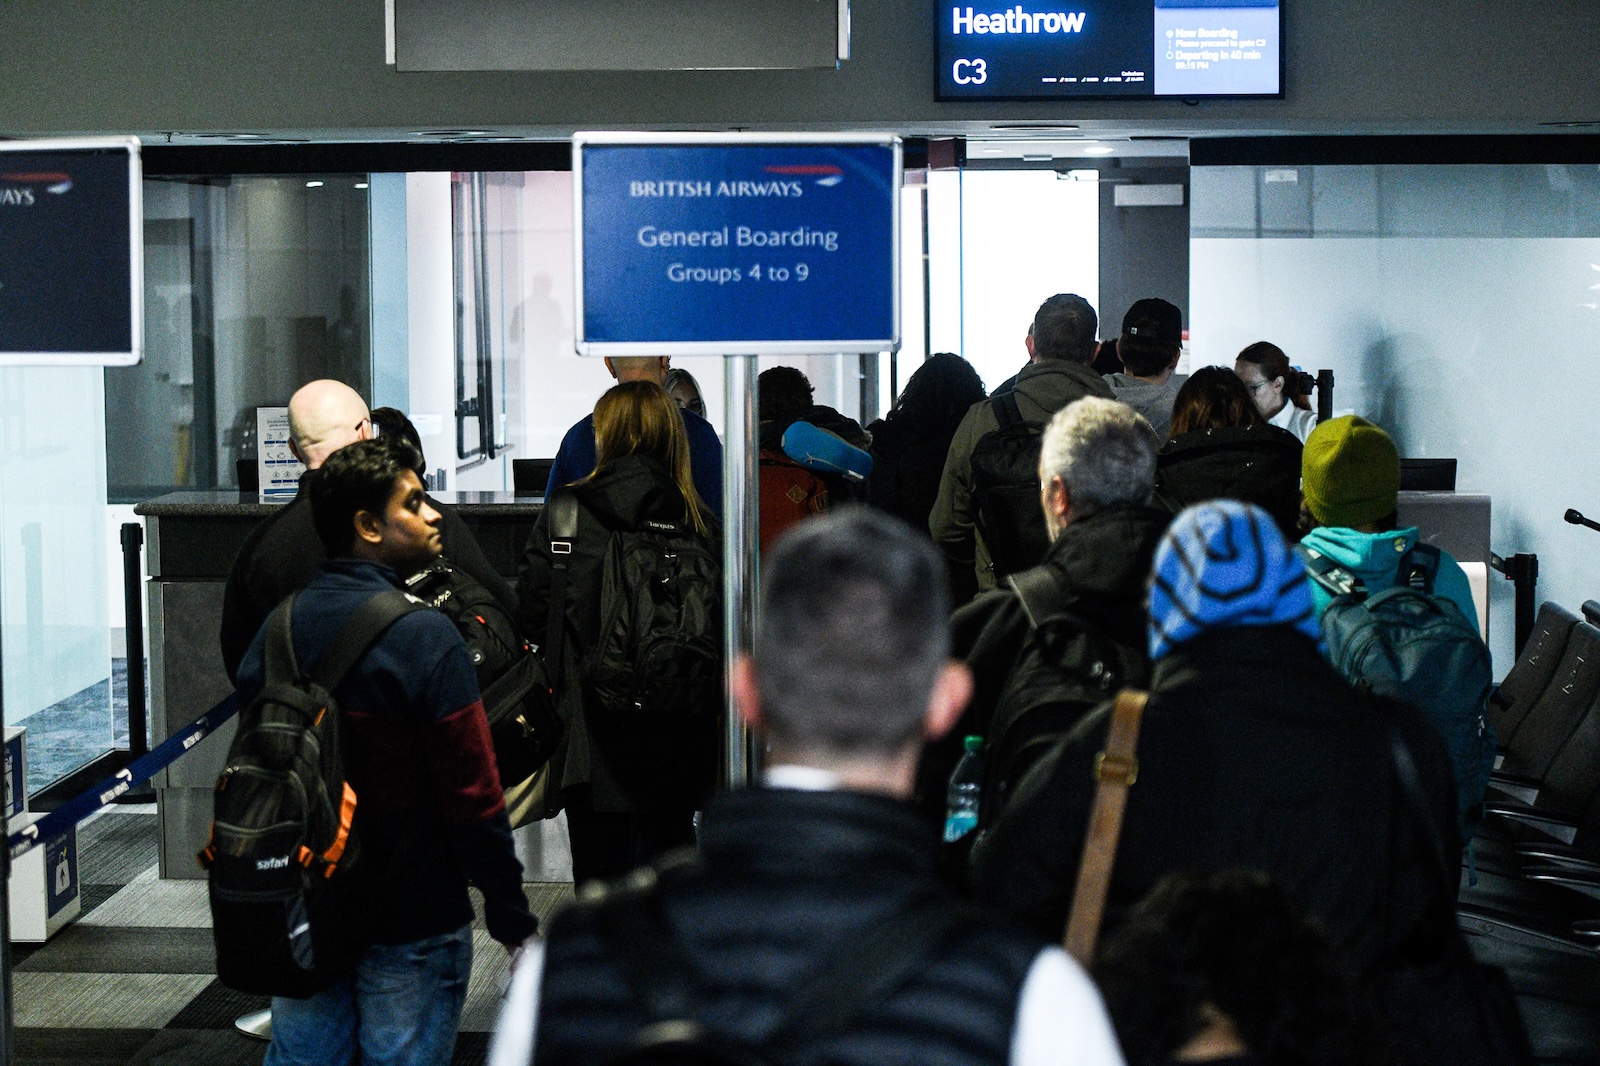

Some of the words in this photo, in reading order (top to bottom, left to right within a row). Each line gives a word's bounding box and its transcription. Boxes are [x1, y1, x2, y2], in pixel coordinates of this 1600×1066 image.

[952, 6, 1086, 34] Heathrow
[1175, 28, 1197, 38] Now
[1198, 27, 1238, 39] Boarding
[1175, 50, 1219, 62] Departing
[1220, 50, 1229, 59] in
[1243, 50, 1261, 60] min
[952, 58, 988, 84] C3
[629, 180, 712, 197] BRITISH
[716, 180, 803, 197] AIRWAYS
[637, 226, 729, 248] General
[735, 226, 839, 251] Boarding
[667, 262, 742, 285] Groups
[748, 263, 762, 282] 4
[768, 264, 790, 282] to
[794, 263, 809, 282] 9
[256, 855, 290, 870] safari
